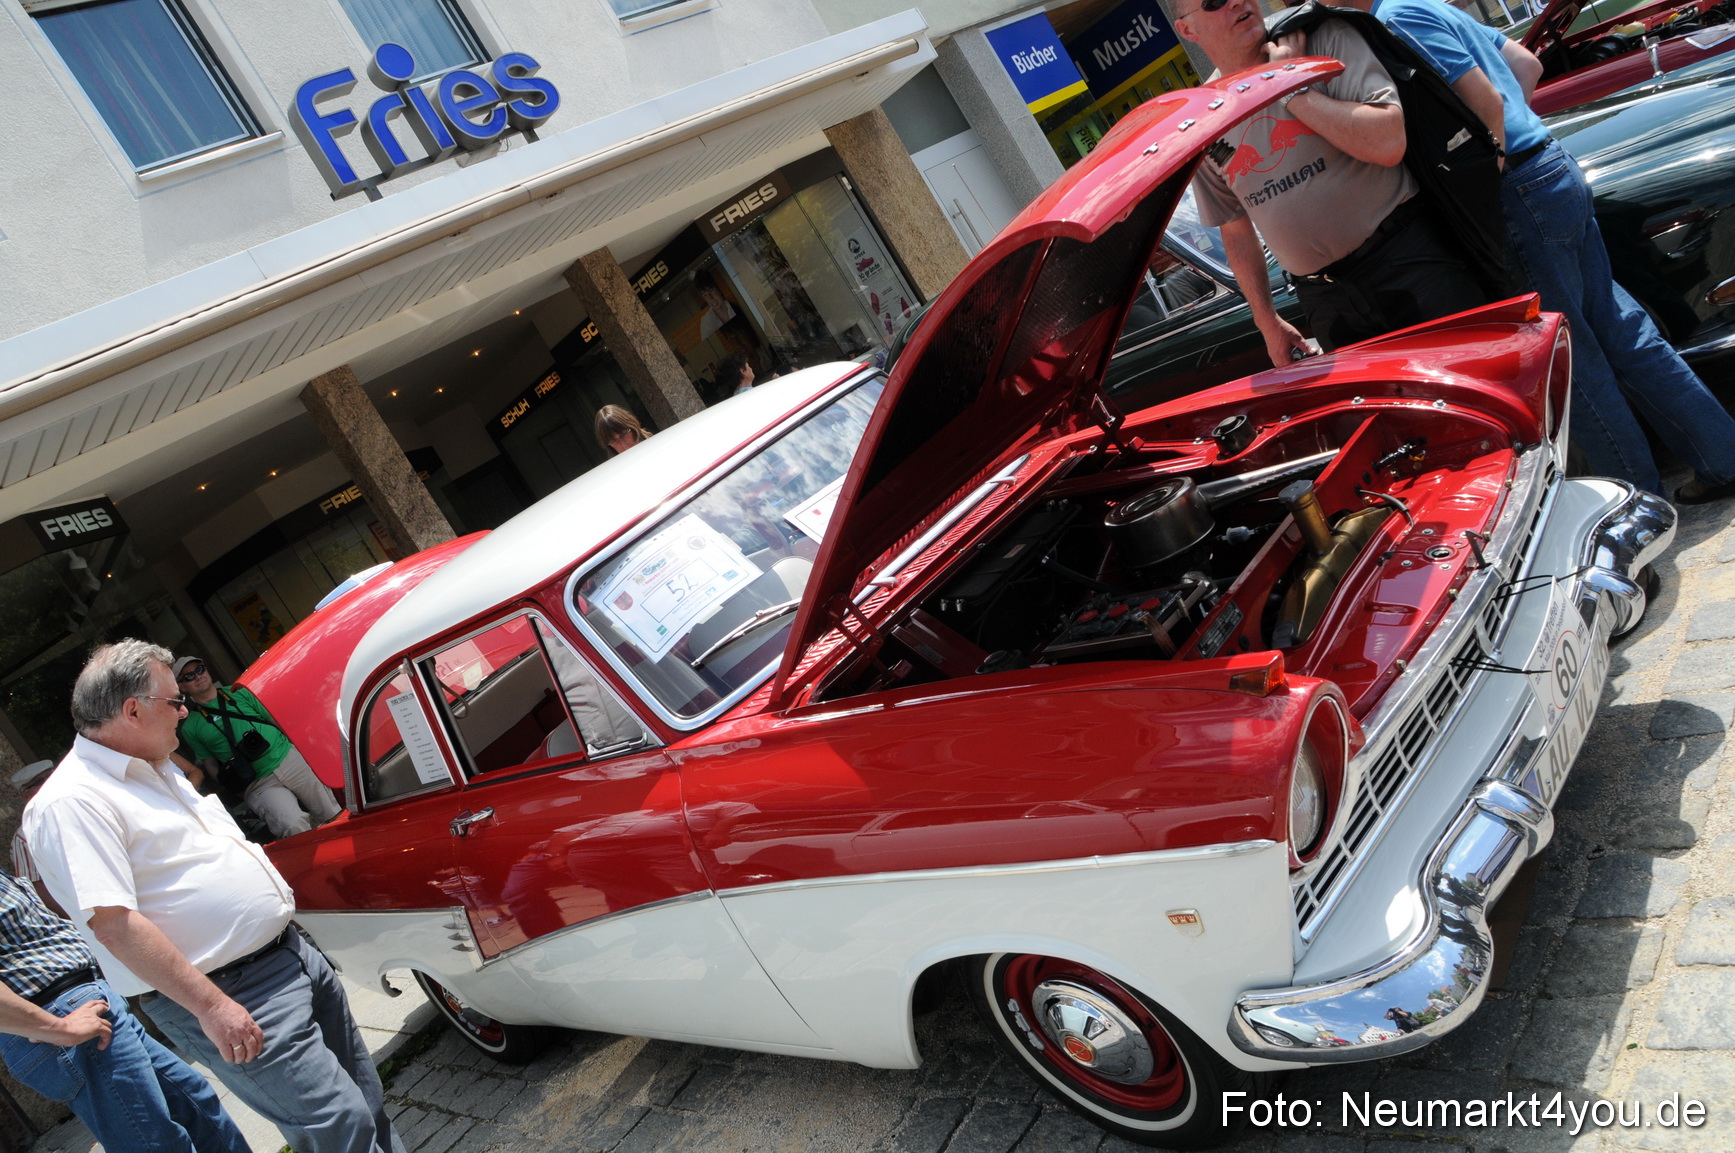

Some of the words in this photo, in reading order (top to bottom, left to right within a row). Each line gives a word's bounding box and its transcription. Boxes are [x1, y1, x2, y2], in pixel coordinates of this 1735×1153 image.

[1011, 45, 1058, 75] Bücher
[1092, 14, 1161, 71] Musik
[709, 182, 778, 233] FRIES
[500, 397, 531, 429] SCHUH
[534, 371, 561, 399] FRIES
[40, 507, 113, 541] FRIES
[319, 485, 362, 515] FRIE
[666, 573, 699, 603] 52
[1556, 639, 1577, 699] 60
[1536, 723, 1571, 804] LAU
[1575, 685, 1593, 735] VL
